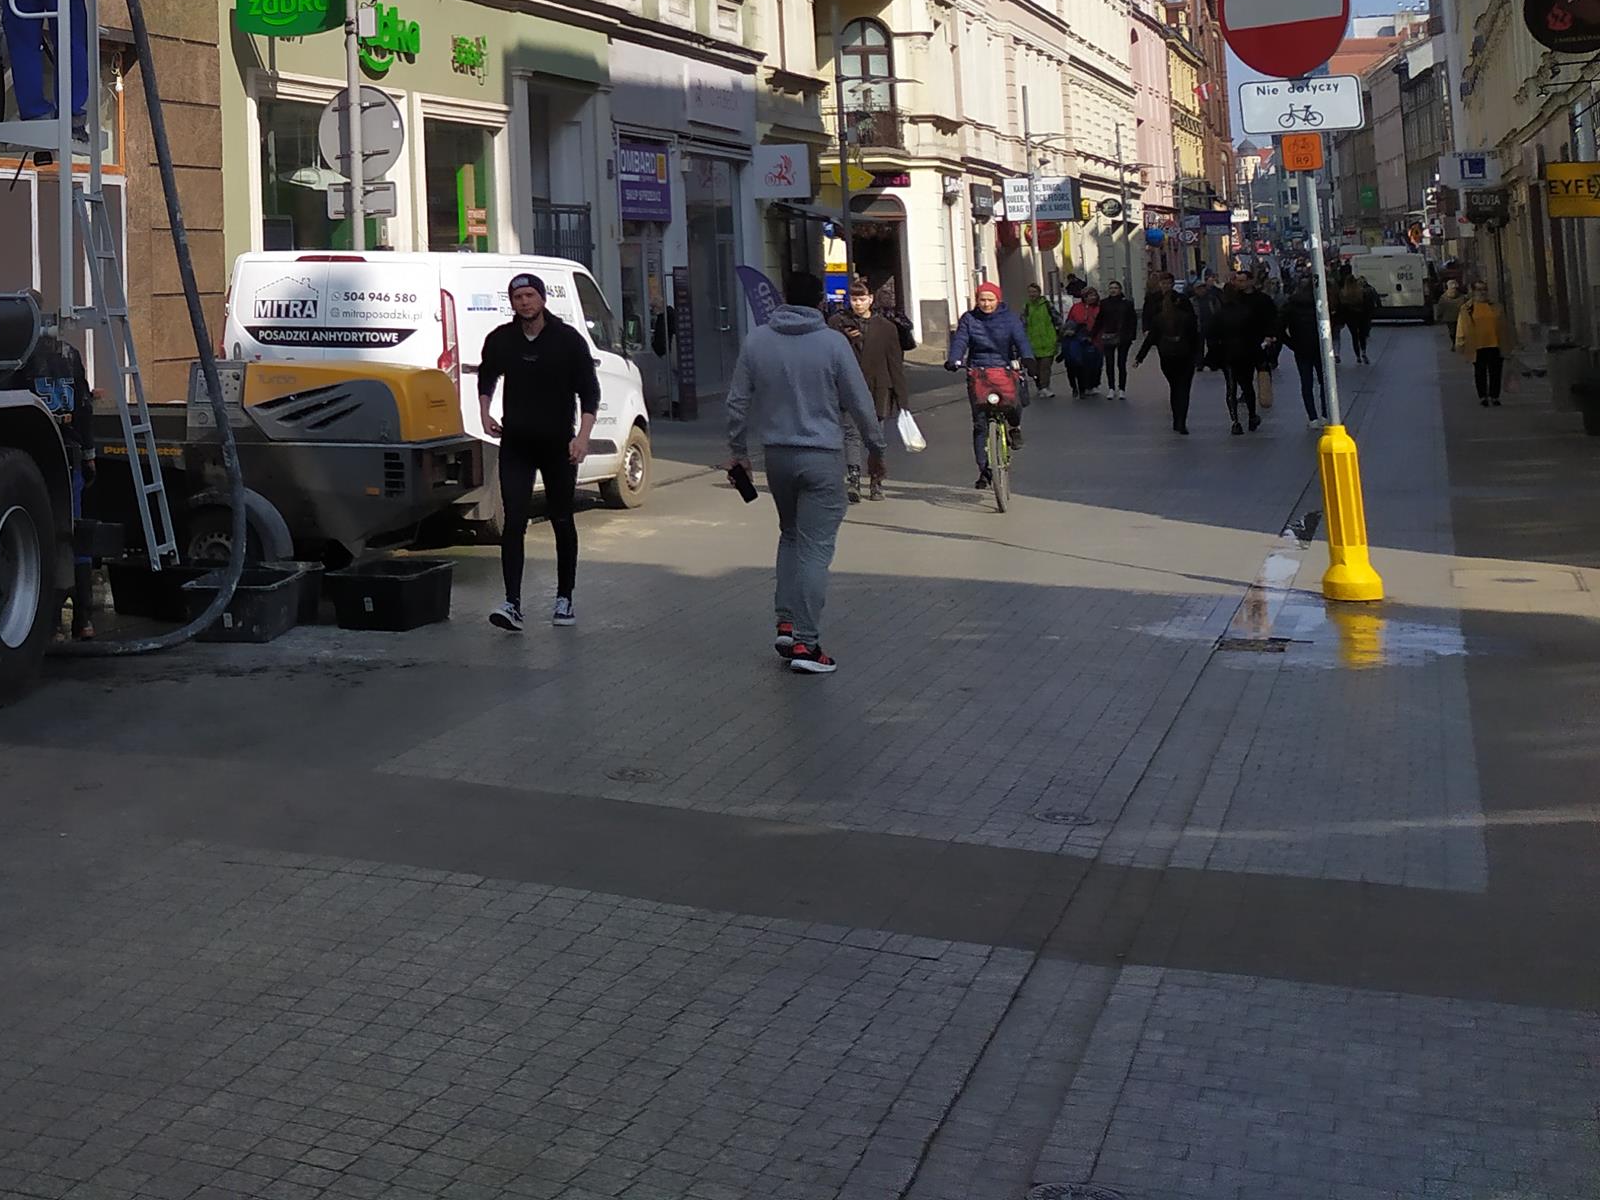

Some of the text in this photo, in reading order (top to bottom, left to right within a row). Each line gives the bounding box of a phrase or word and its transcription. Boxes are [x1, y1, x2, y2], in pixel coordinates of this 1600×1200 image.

[1256, 82, 1339, 96] Nie dotyczy
[620, 149, 657, 174] OMBARD
[343, 291, 417, 303] 504 946 580
[255, 300, 317, 318] MITRA
[342, 308, 423, 322] mitraposadzki.pl
[258, 329, 399, 343] POSADZKI ANHYDRYTOWE
